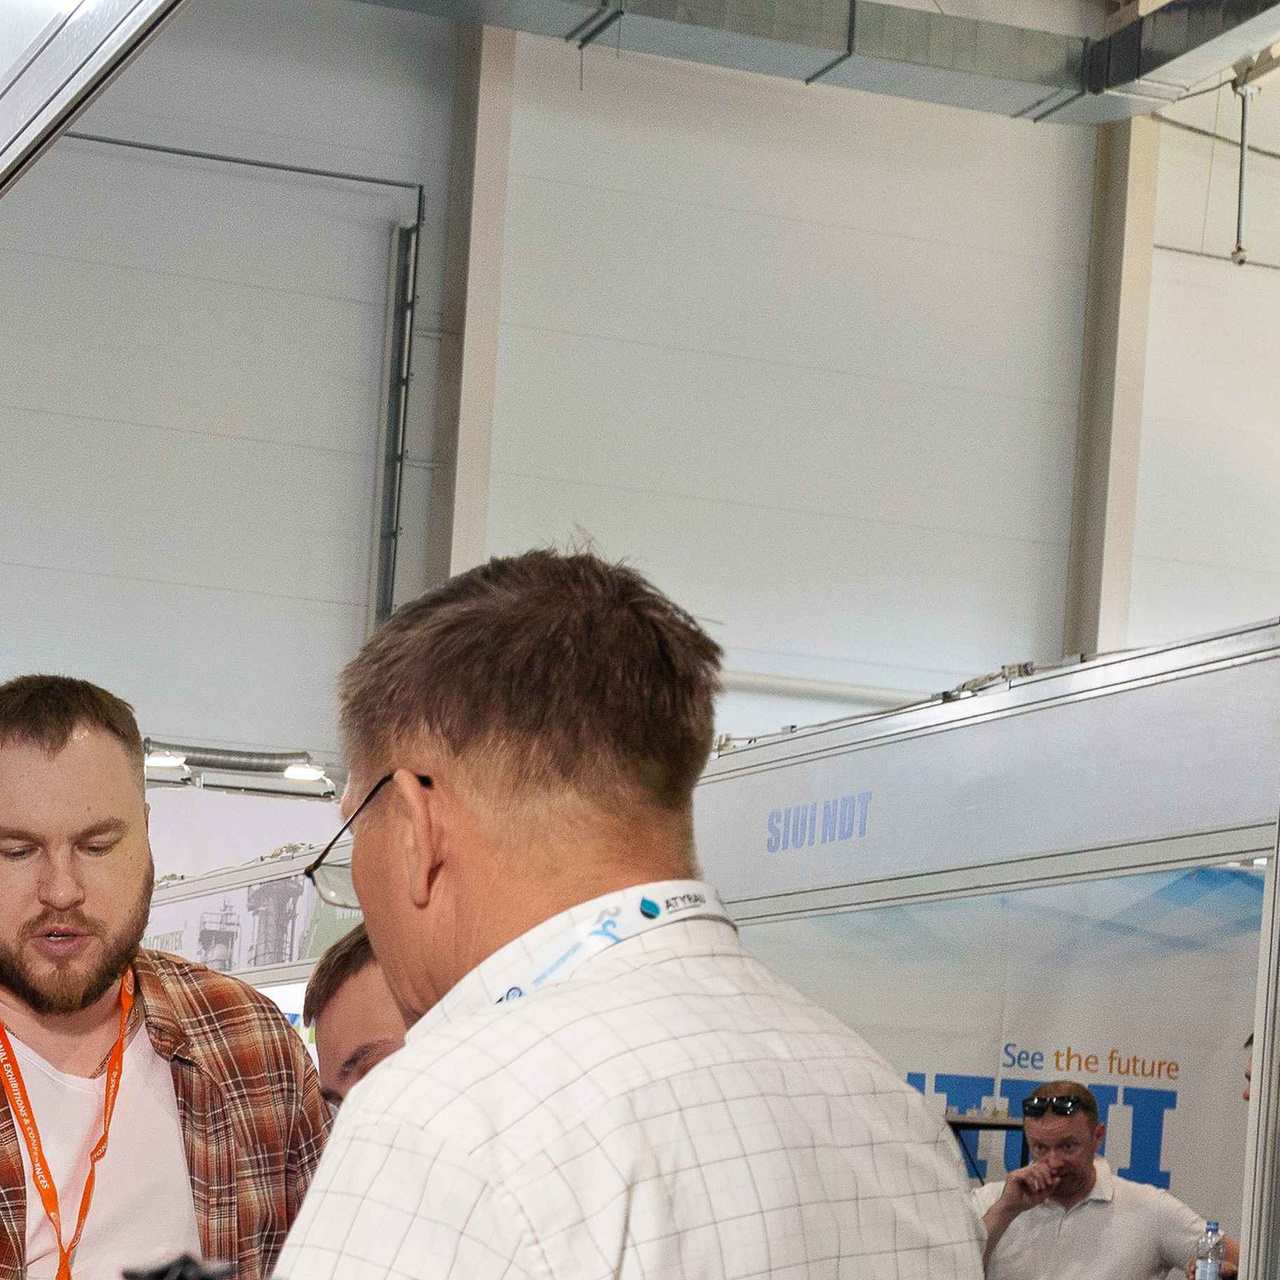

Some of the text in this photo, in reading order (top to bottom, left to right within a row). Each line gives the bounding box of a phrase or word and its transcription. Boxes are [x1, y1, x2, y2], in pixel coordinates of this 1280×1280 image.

[766, 790, 872, 854] SIUI NDT
[1002, 1043, 1180, 1080] See the future
[3, 1063, 28, 1118] EXHIBITIONS
